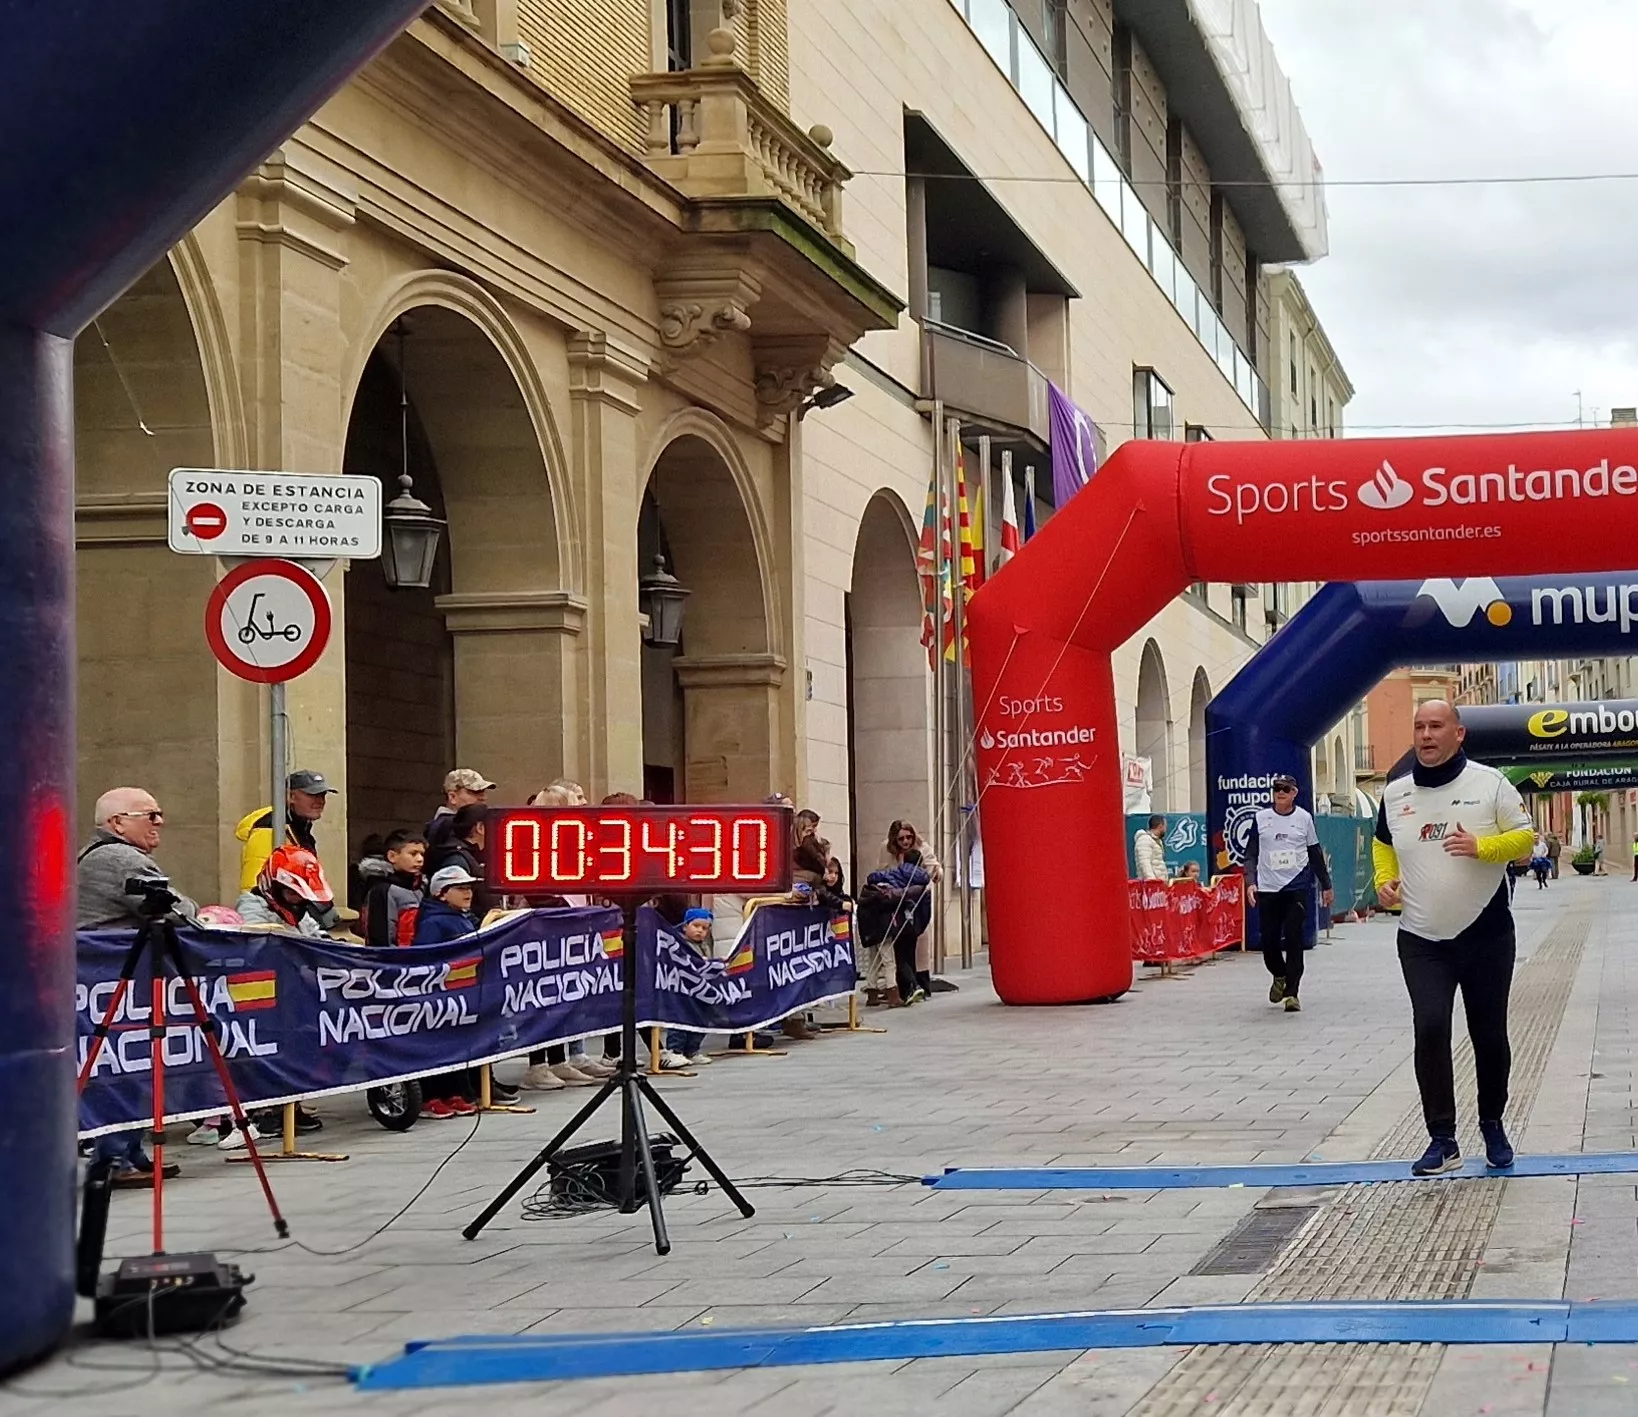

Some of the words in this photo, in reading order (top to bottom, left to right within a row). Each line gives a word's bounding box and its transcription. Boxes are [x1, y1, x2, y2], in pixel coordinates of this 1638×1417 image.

[185, 481, 237, 495] ZONA
[243, 483, 266, 496] DE
[272, 484, 366, 499] ESTANCIA
[1206, 473, 1349, 525] Sports
[241, 501, 309, 513] EXCEPTO
[314, 503, 365, 515] CARGA
[242, 517, 250, 526] Y
[255, 517, 336, 529] DESCARGA
[241, 533, 260, 545] DE
[264, 534, 273, 545] 9
[278, 534, 289, 545] A
[294, 535, 305, 545] 11
[308, 535, 360, 547] HORAS
[1351, 524, 1503, 547] sportssantander.es
[999, 694, 1064, 719] Sports
[996, 725, 1097, 749] Santander
[1550, 779, 1571, 788] CAJA
[1573, 777, 1600, 787] RURAL
[1601, 777, 1613, 785] DE
[1228, 788, 1275, 806] mupol
[505, 819, 767, 881] 00:34:30
[501, 962, 624, 1018] NACIONAL
[319, 994, 479, 1047] NACIONAL
